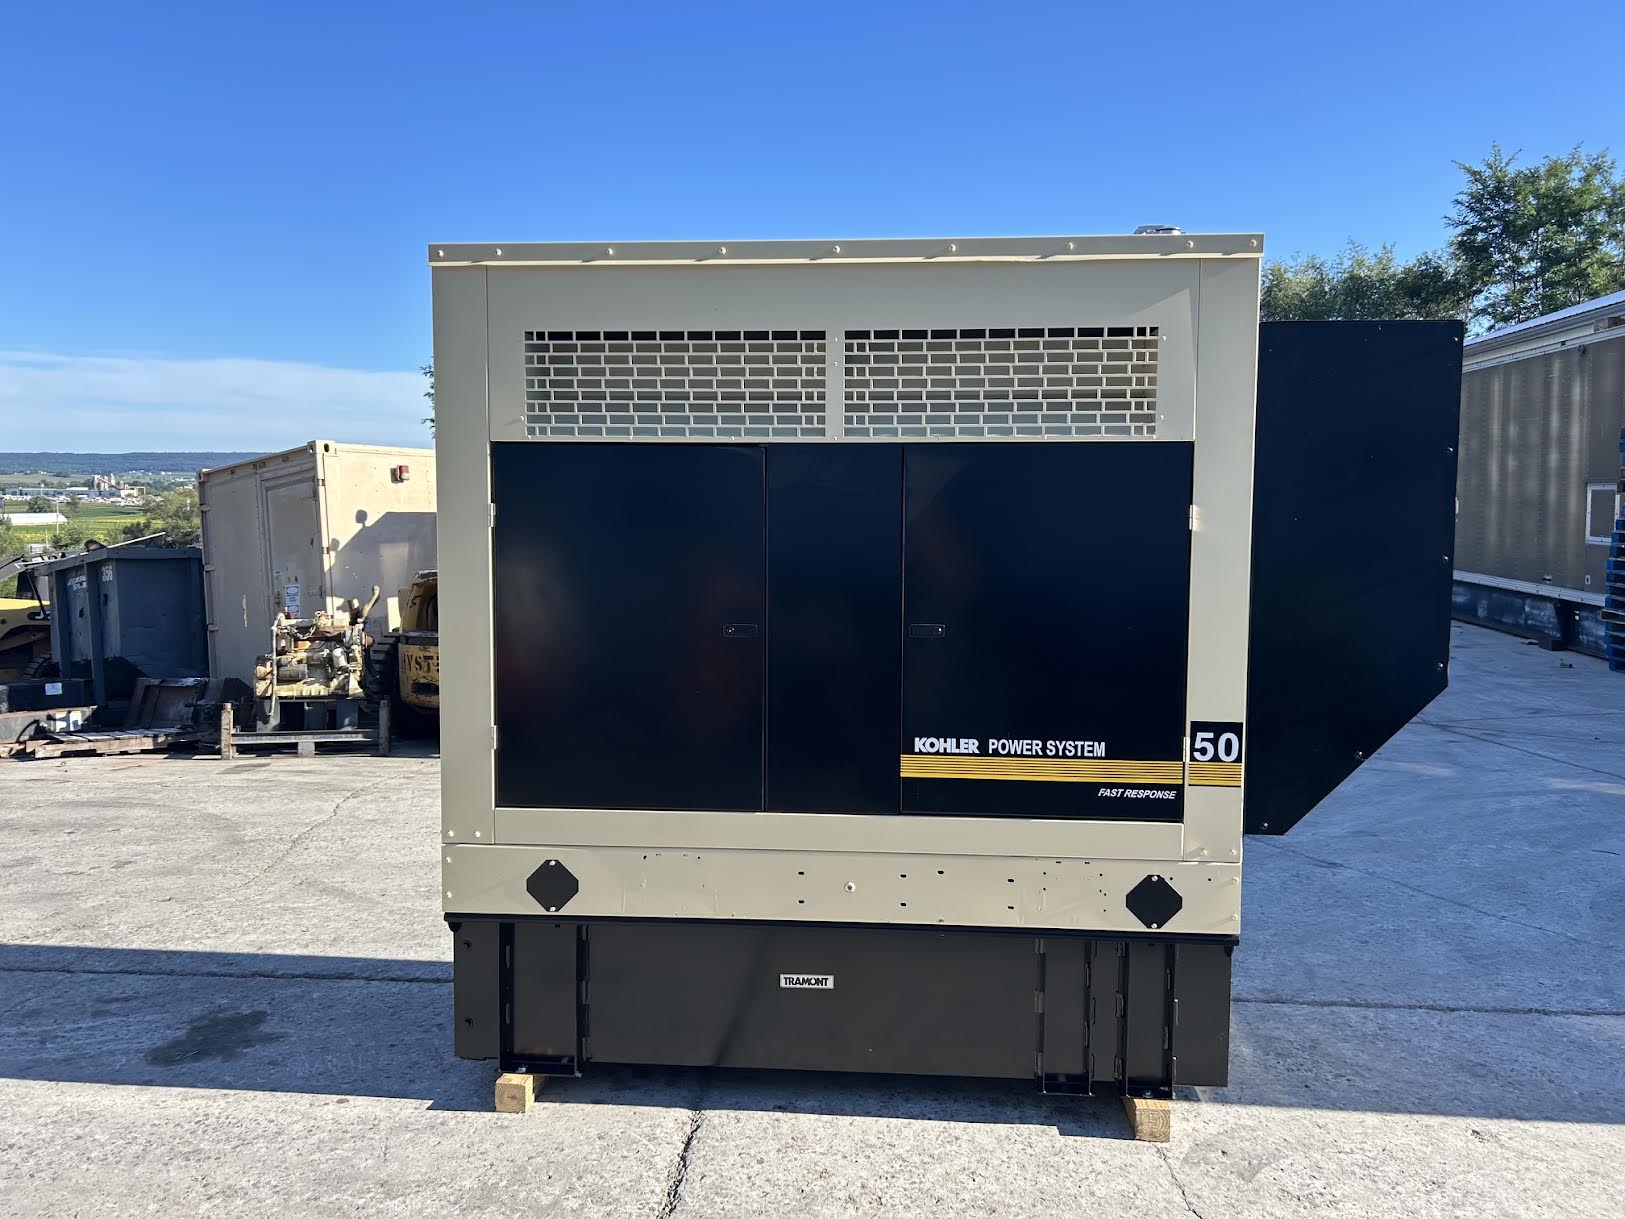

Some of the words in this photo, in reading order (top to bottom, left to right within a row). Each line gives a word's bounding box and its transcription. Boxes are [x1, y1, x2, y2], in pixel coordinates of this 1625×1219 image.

[401, 653, 440, 673] HYST
[914, 737, 980, 754] KOHLER
[988, 738, 1043, 756] POWER
[1046, 740, 1106, 757] SYSTEM
[1193, 732, 1240, 763] 50
[1098, 788, 1123, 798] FAST
[1123, 789, 1177, 800] RESPONSE
[783, 976, 829, 987] TRAMONT
